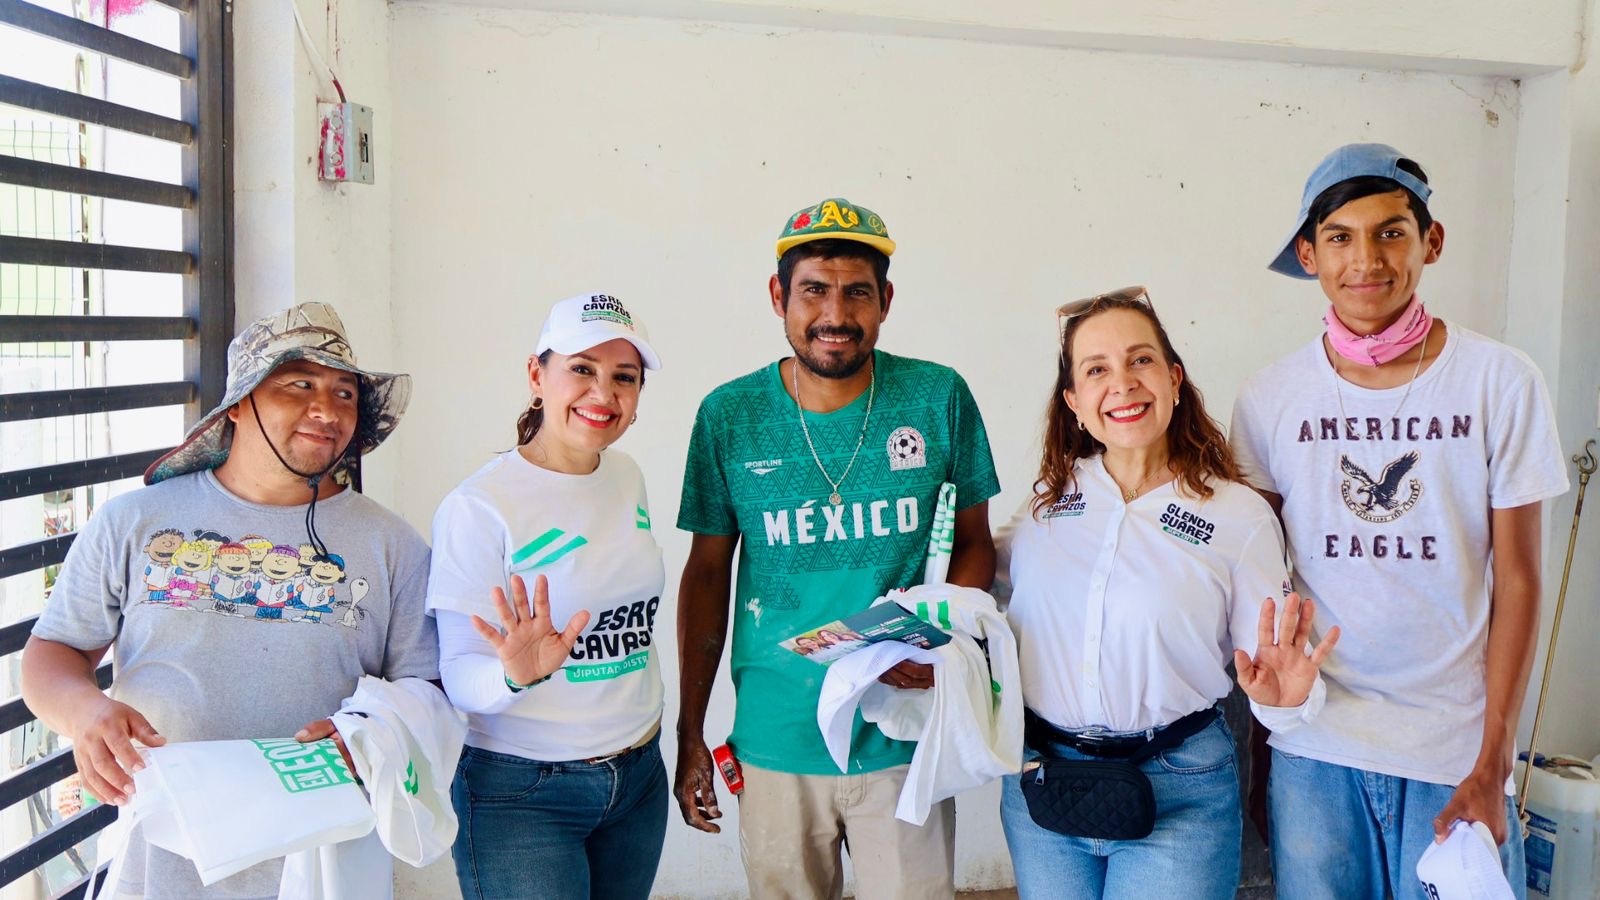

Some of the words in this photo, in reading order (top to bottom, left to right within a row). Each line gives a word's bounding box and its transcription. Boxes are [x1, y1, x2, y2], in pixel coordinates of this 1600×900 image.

[812, 200, 859, 229] A's
[583, 302, 632, 319] CAVAZOS
[591, 294, 623, 307] ESRA
[1298, 415, 1472, 442] AMERICAN
[744, 458, 783, 469] SPORTLINE
[763, 497, 919, 546] MÉXICO
[1160, 513, 1212, 545] SUÁREZ
[1167, 503, 1215, 534] GLENDA
[1325, 534, 1436, 560] EAGLE
[591, 596, 660, 634] ESRA
